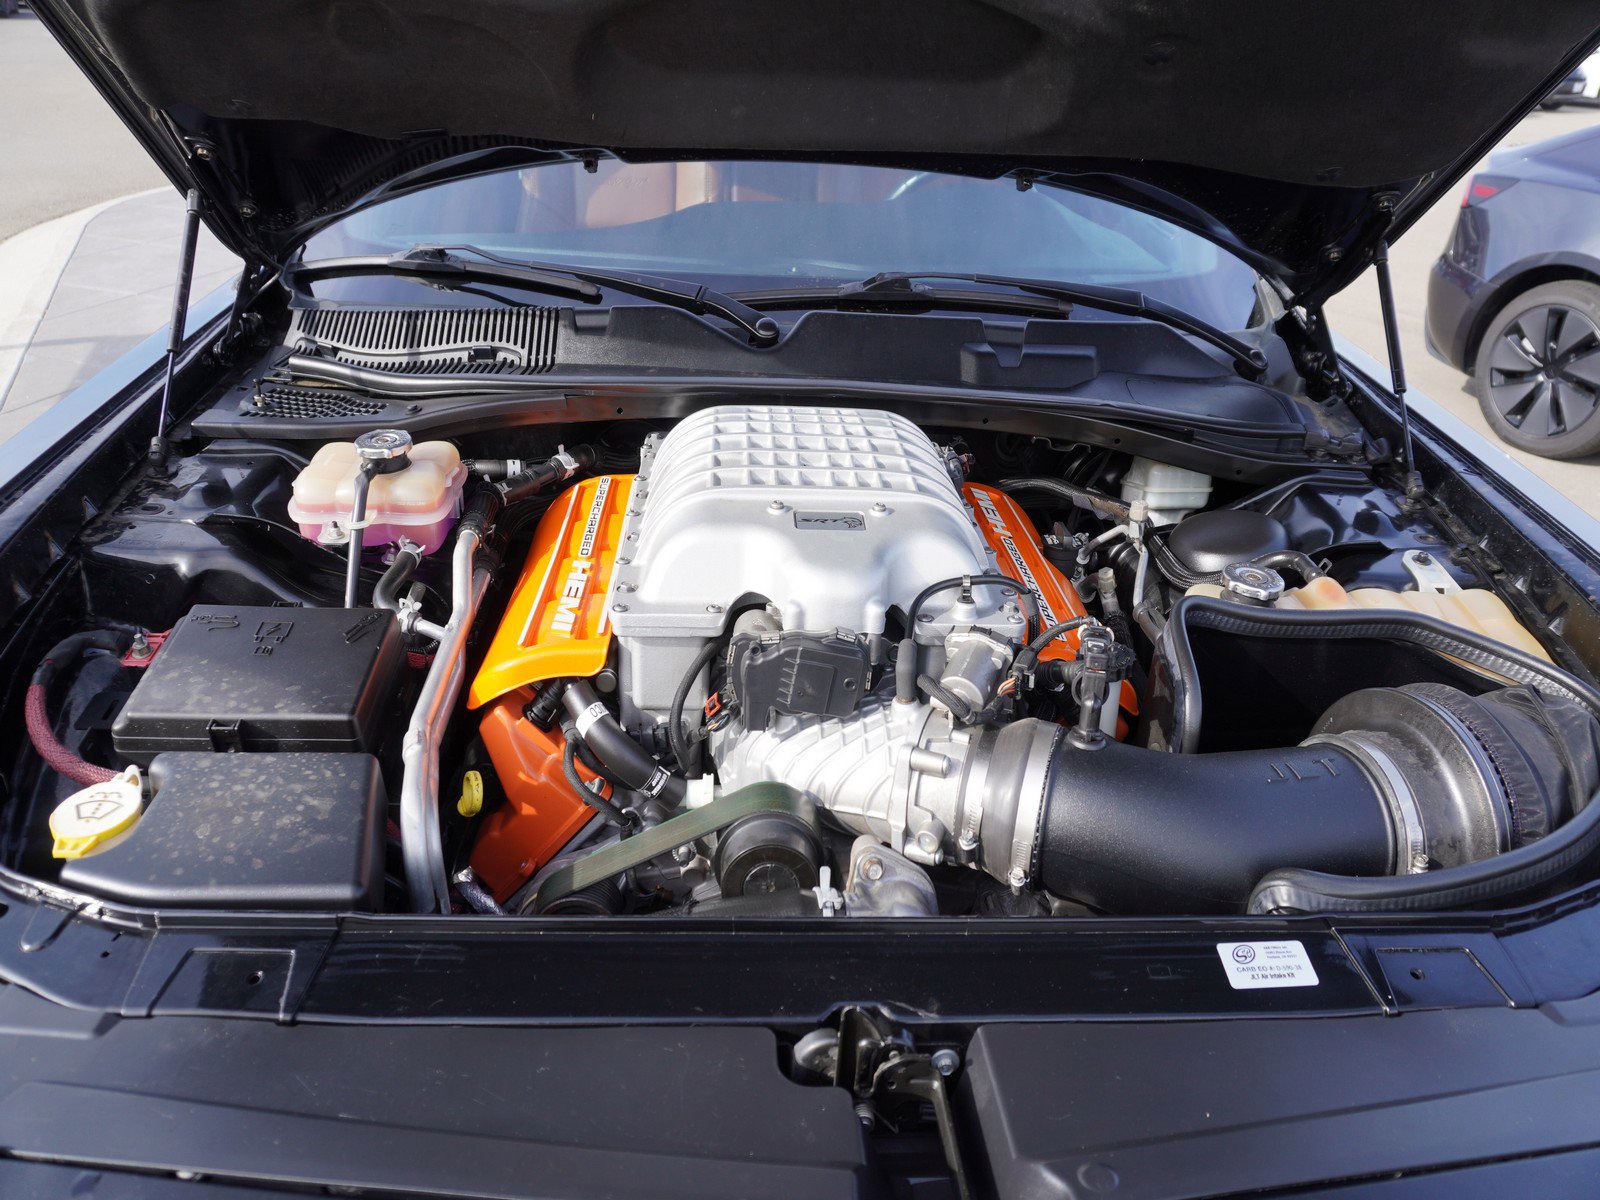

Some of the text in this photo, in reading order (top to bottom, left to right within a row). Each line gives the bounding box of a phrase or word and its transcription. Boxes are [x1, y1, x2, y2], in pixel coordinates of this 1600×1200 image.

[970, 487, 1013, 539] HEMI
[551, 477, 611, 632] SUPERCHARGED HEMI
[1266, 758, 1337, 783] JLT
